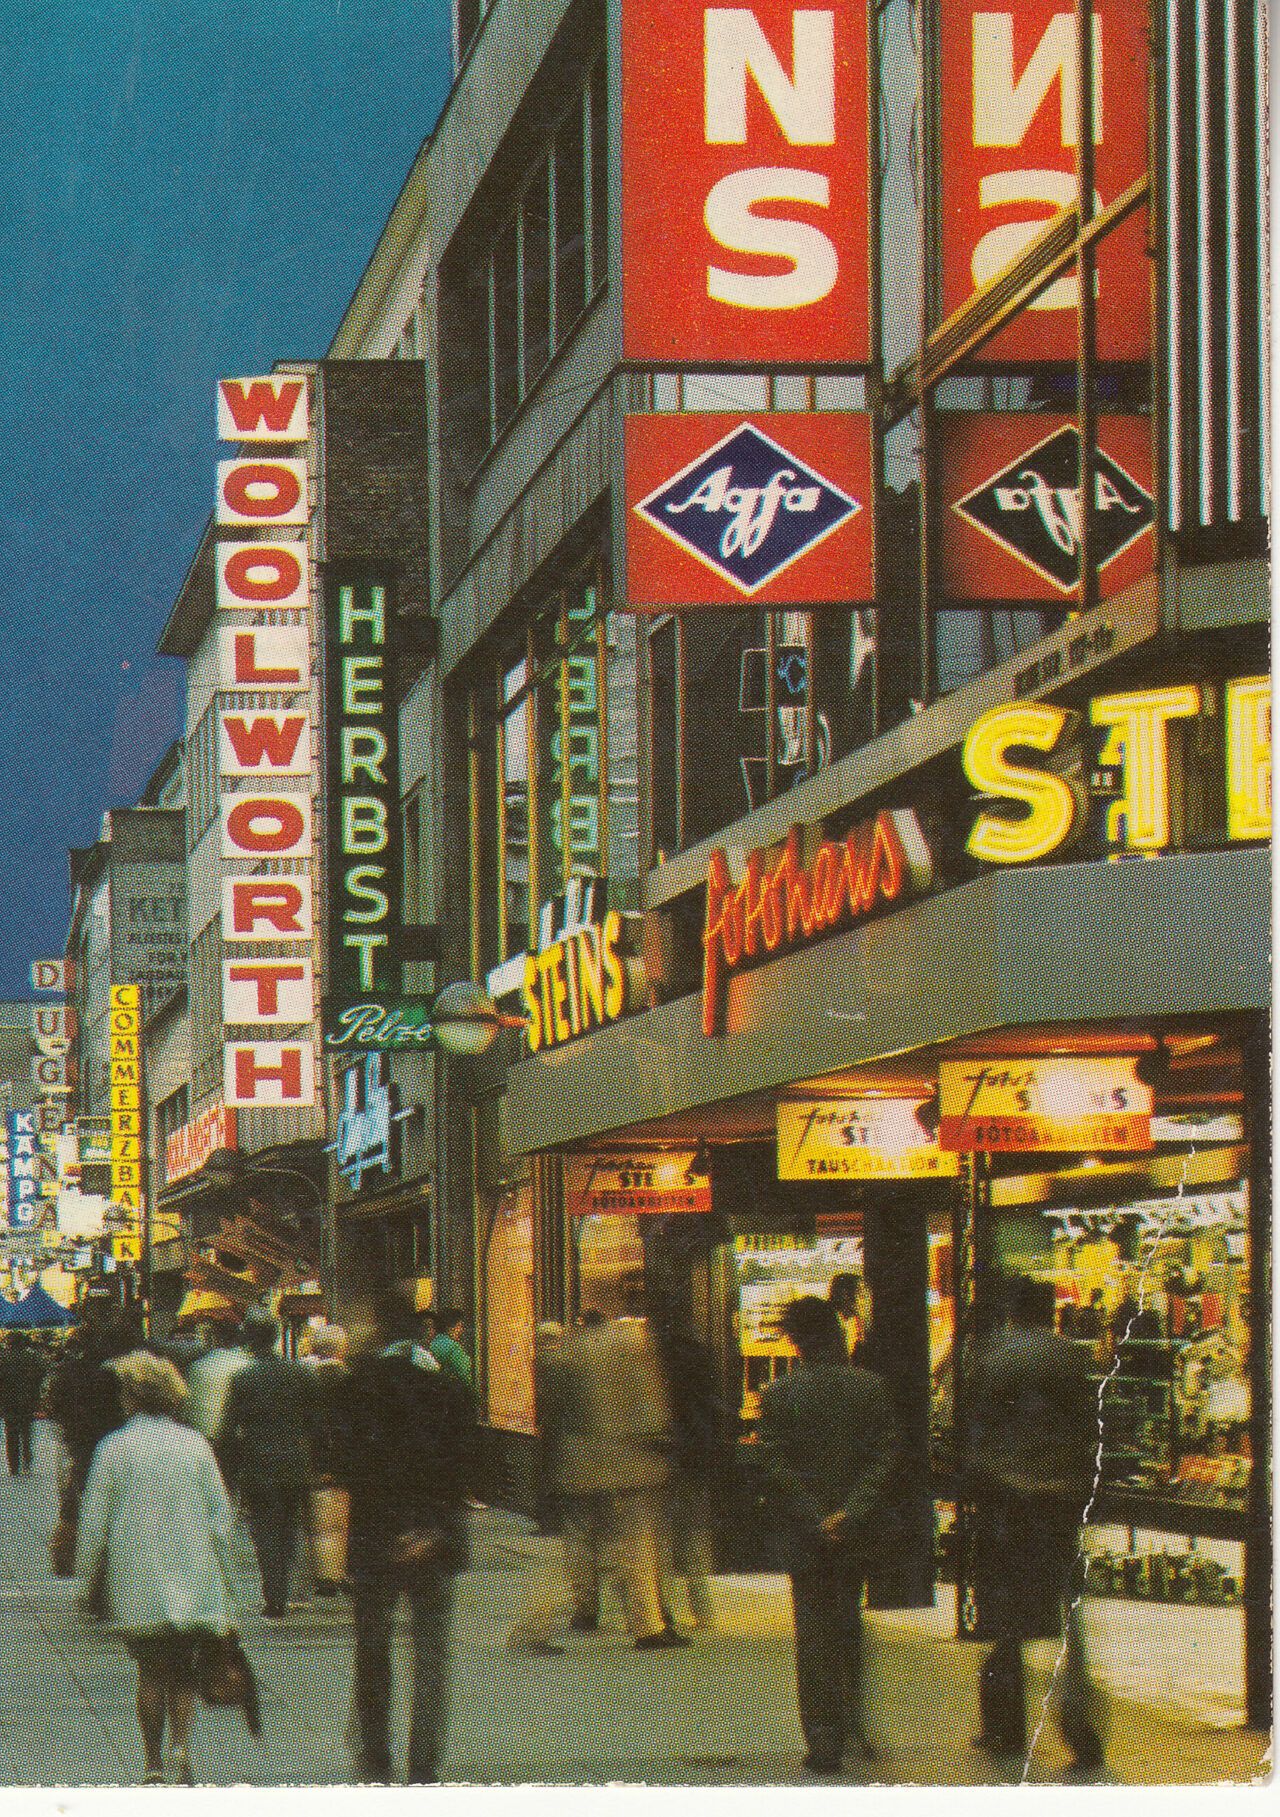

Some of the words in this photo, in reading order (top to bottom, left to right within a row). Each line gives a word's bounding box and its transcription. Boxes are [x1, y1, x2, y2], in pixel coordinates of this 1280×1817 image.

[667, 465, 822, 560] Agfa
[219, 381, 307, 1100] WOOLWORTH
[338, 585, 389, 992] HERBST
[325, 1003, 431, 1045] Pelze
[524, 910, 623, 1052] STEINS
[703, 811, 904, 1038] fotohaus
[35, 963, 62, 1226] DUGENA
